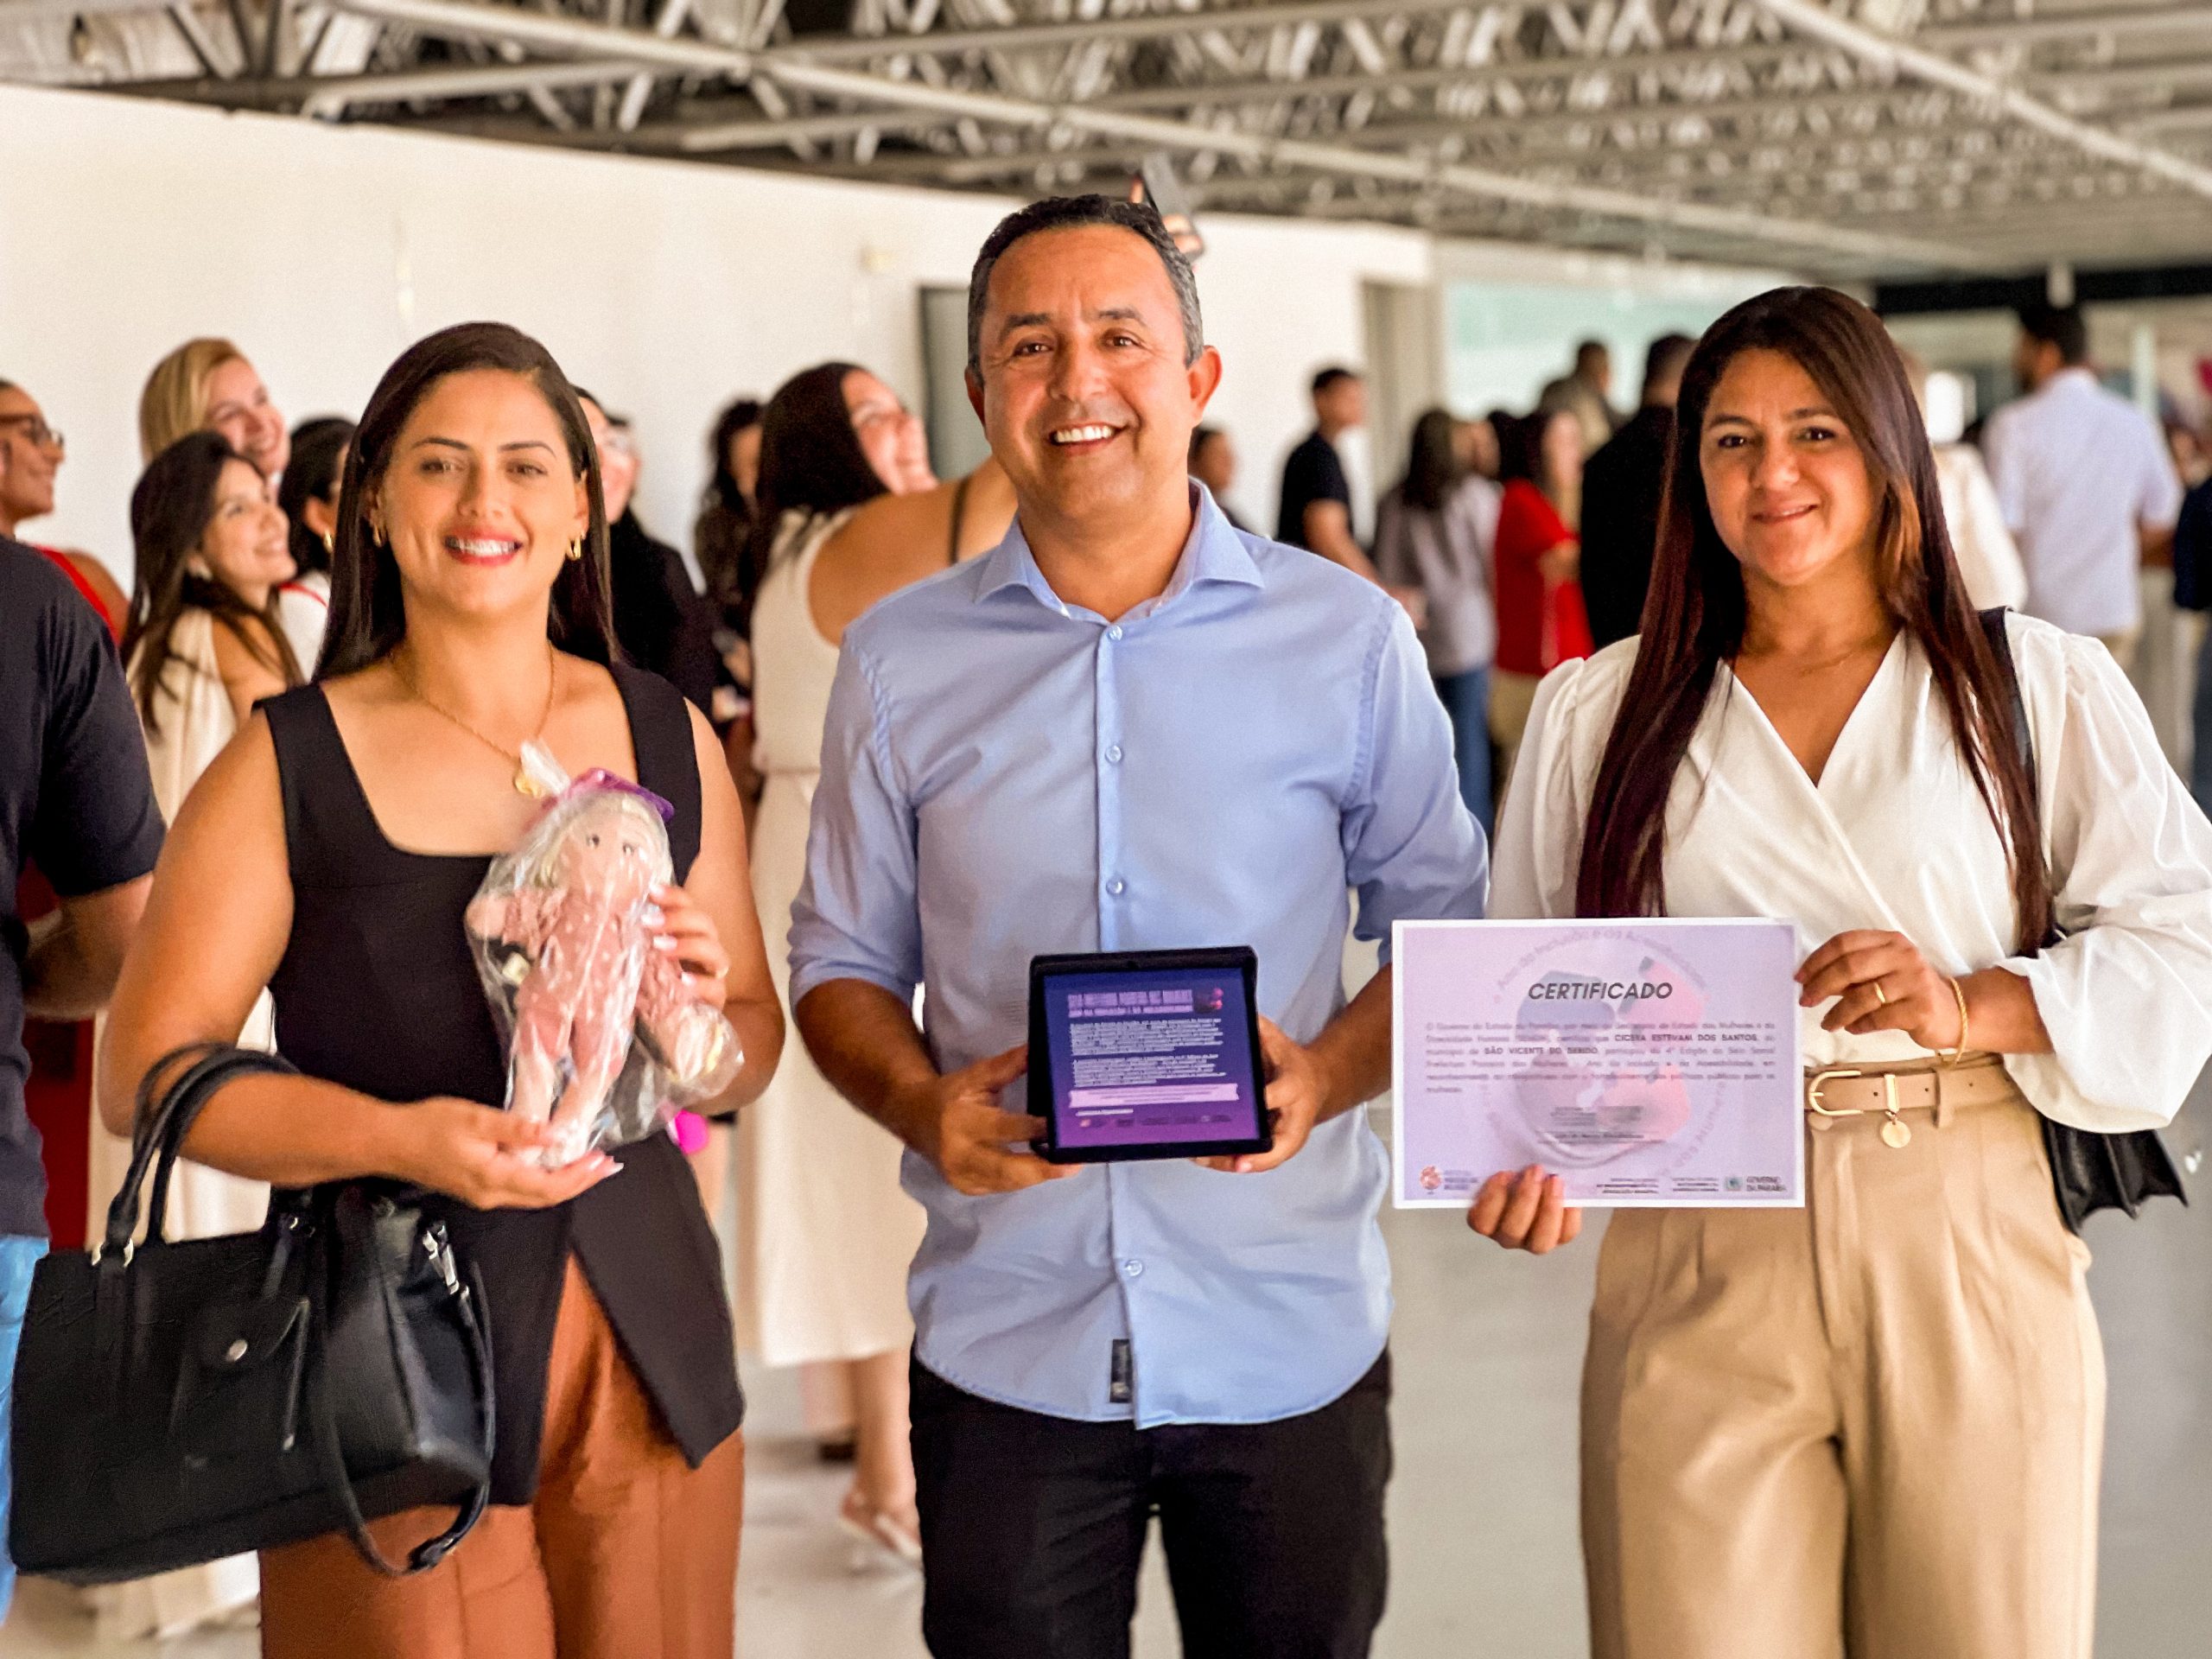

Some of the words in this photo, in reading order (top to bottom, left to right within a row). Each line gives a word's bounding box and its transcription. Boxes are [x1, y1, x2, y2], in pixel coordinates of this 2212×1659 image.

[1528, 982, 1674, 1001] CERTIFICADO
[1697, 1033, 1717, 1042] DOS
[1484, 1045, 1504, 1055] SÃO
